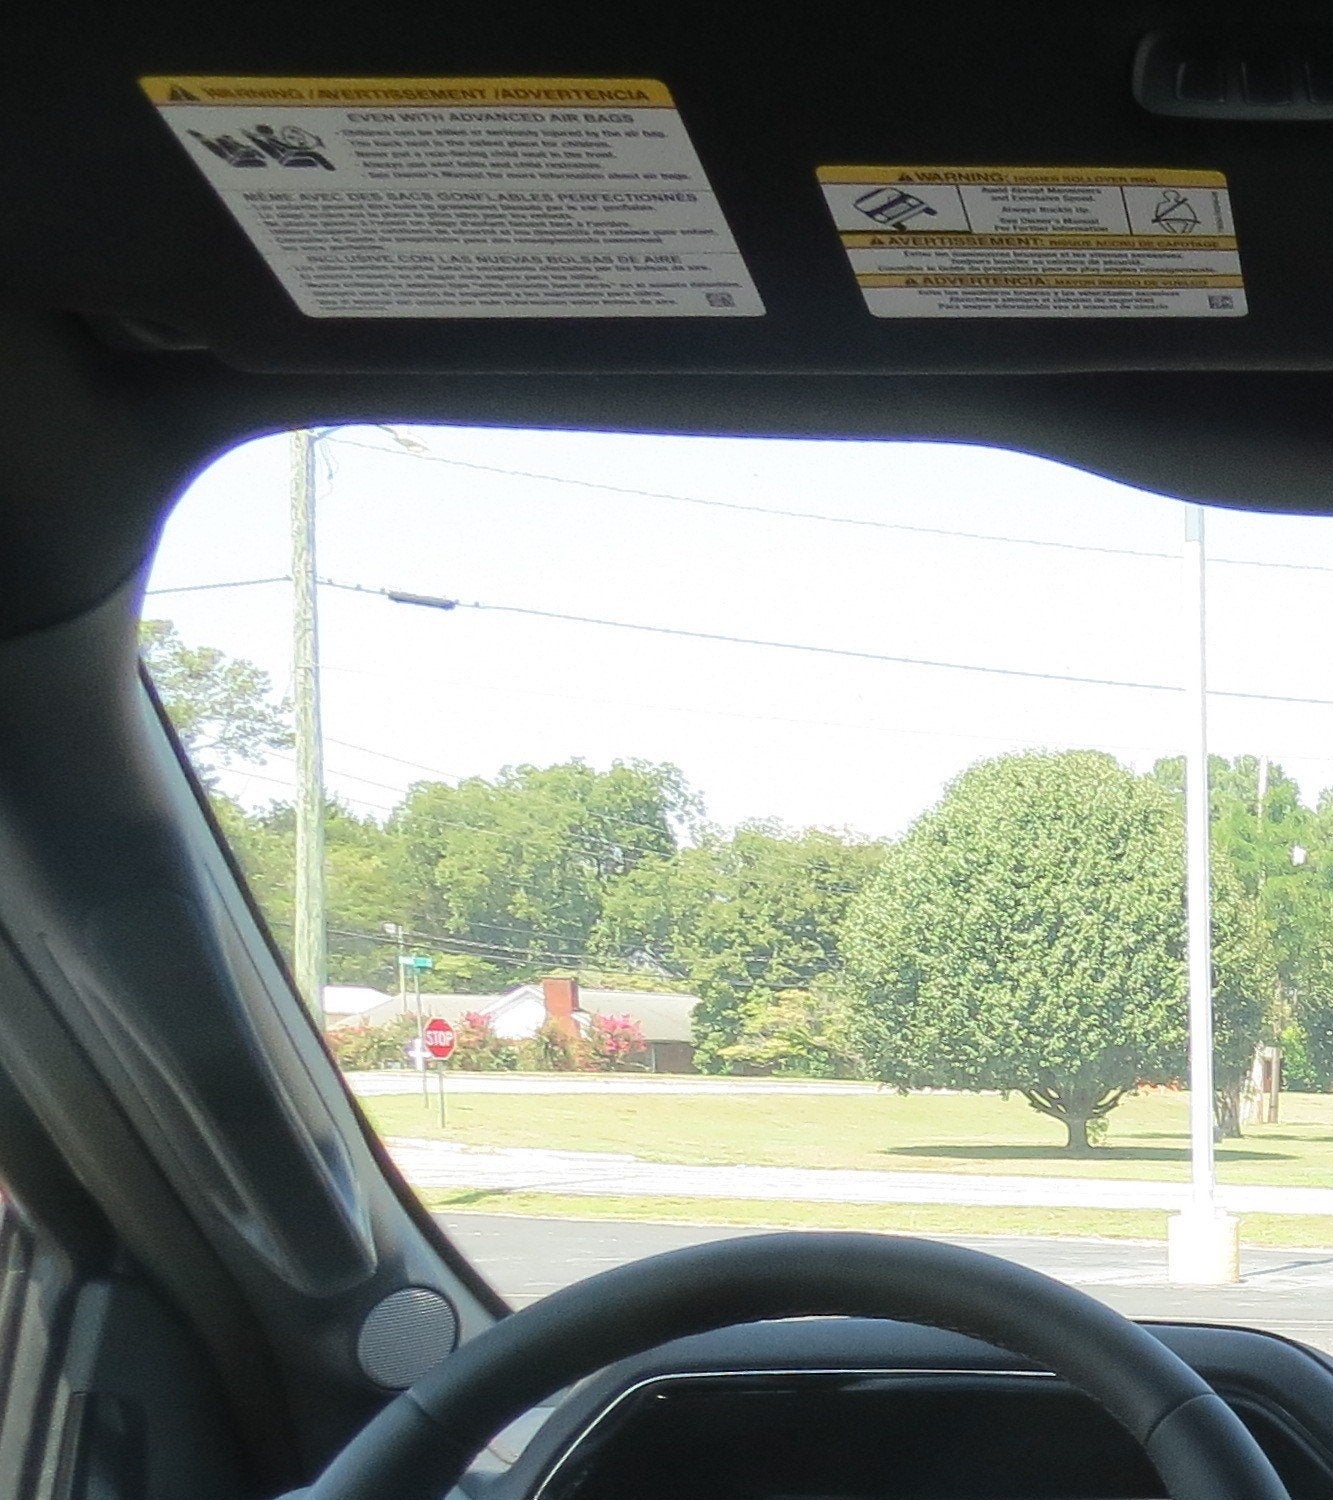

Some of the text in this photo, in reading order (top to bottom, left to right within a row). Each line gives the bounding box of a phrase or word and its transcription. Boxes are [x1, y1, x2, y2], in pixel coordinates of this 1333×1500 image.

[202, 88, 305, 100] WARNING
[347, 112, 396, 122] EVEN
[448, 112, 547, 122] ADVANCED
[549, 113, 580, 122] AIR
[582, 113, 636, 122] BAGS
[426, 1030, 454, 1047] STOP
